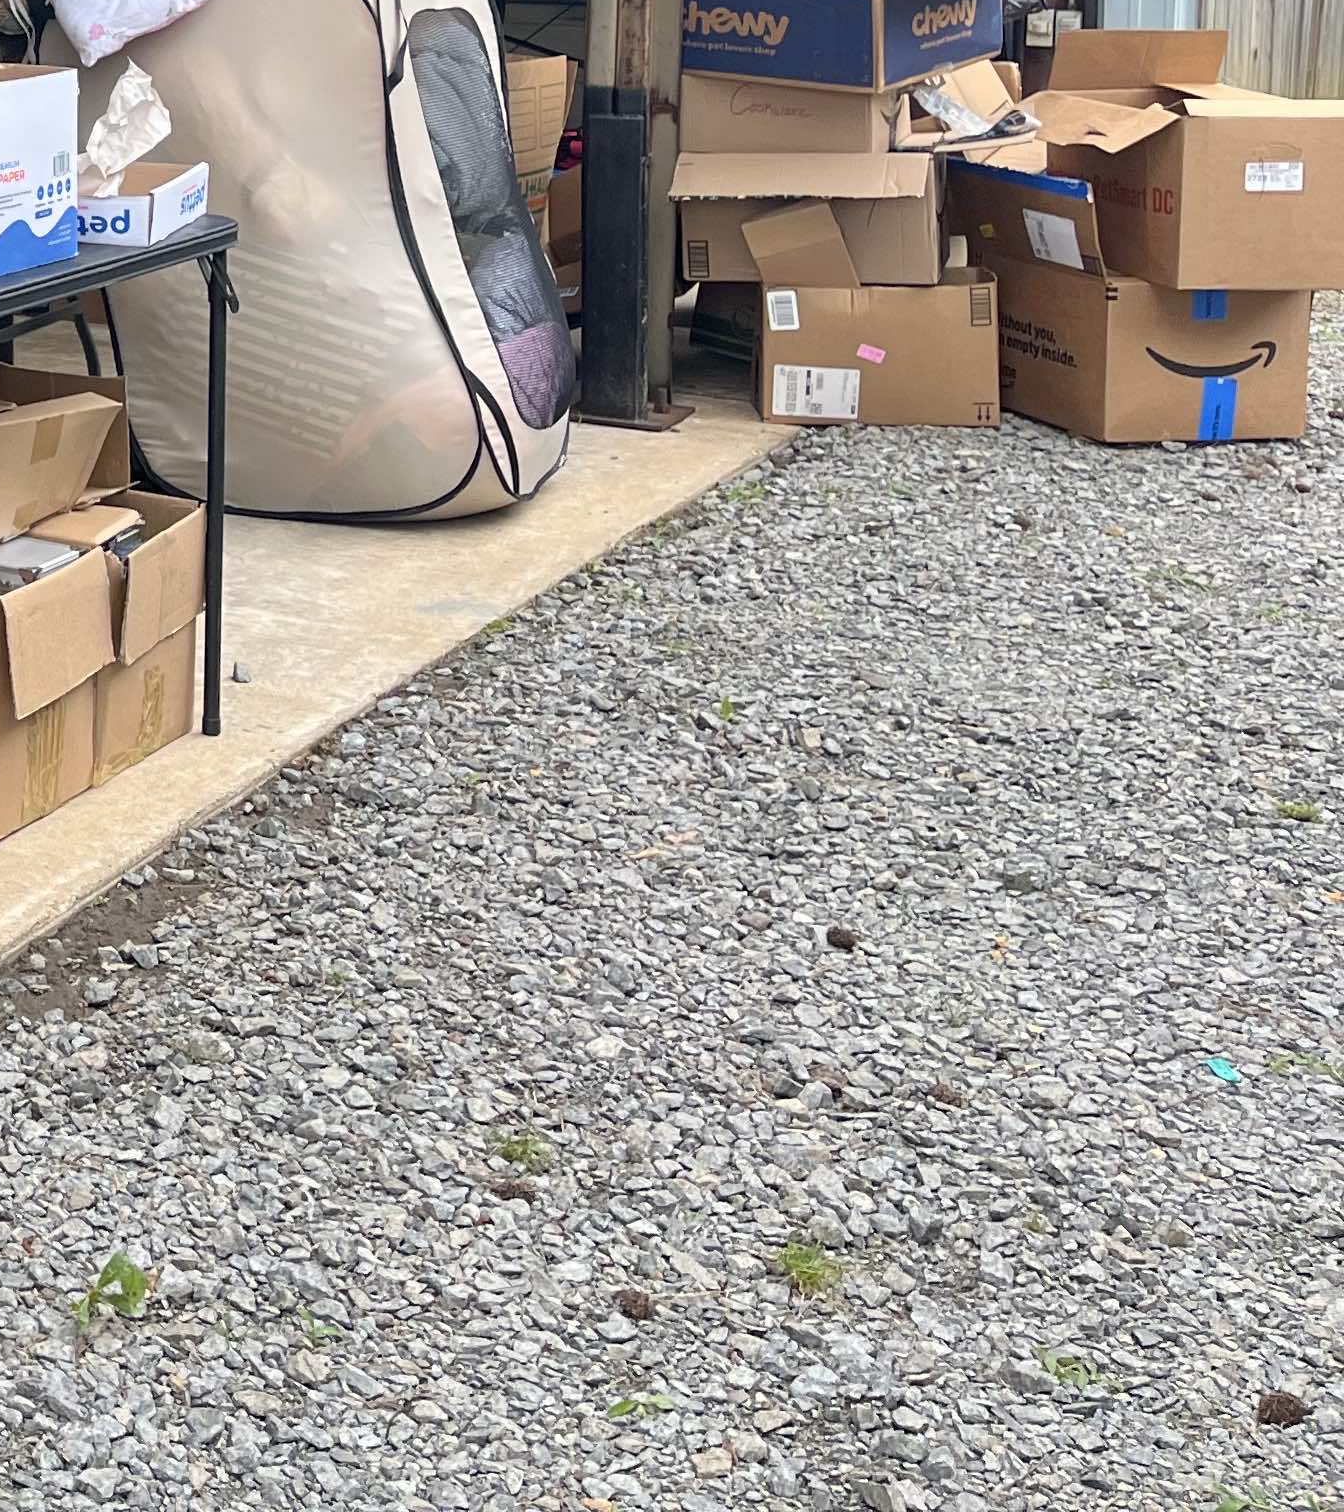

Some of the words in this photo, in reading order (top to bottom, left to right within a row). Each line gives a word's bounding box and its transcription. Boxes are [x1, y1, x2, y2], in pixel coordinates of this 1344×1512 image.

[1151, 186, 1174, 216] DC
[77, 209, 131, 236] pet
[1033, 325, 1057, 346] you,
[1007, 335, 1041, 359] empty
[1041, 343, 1078, 369] inside.
